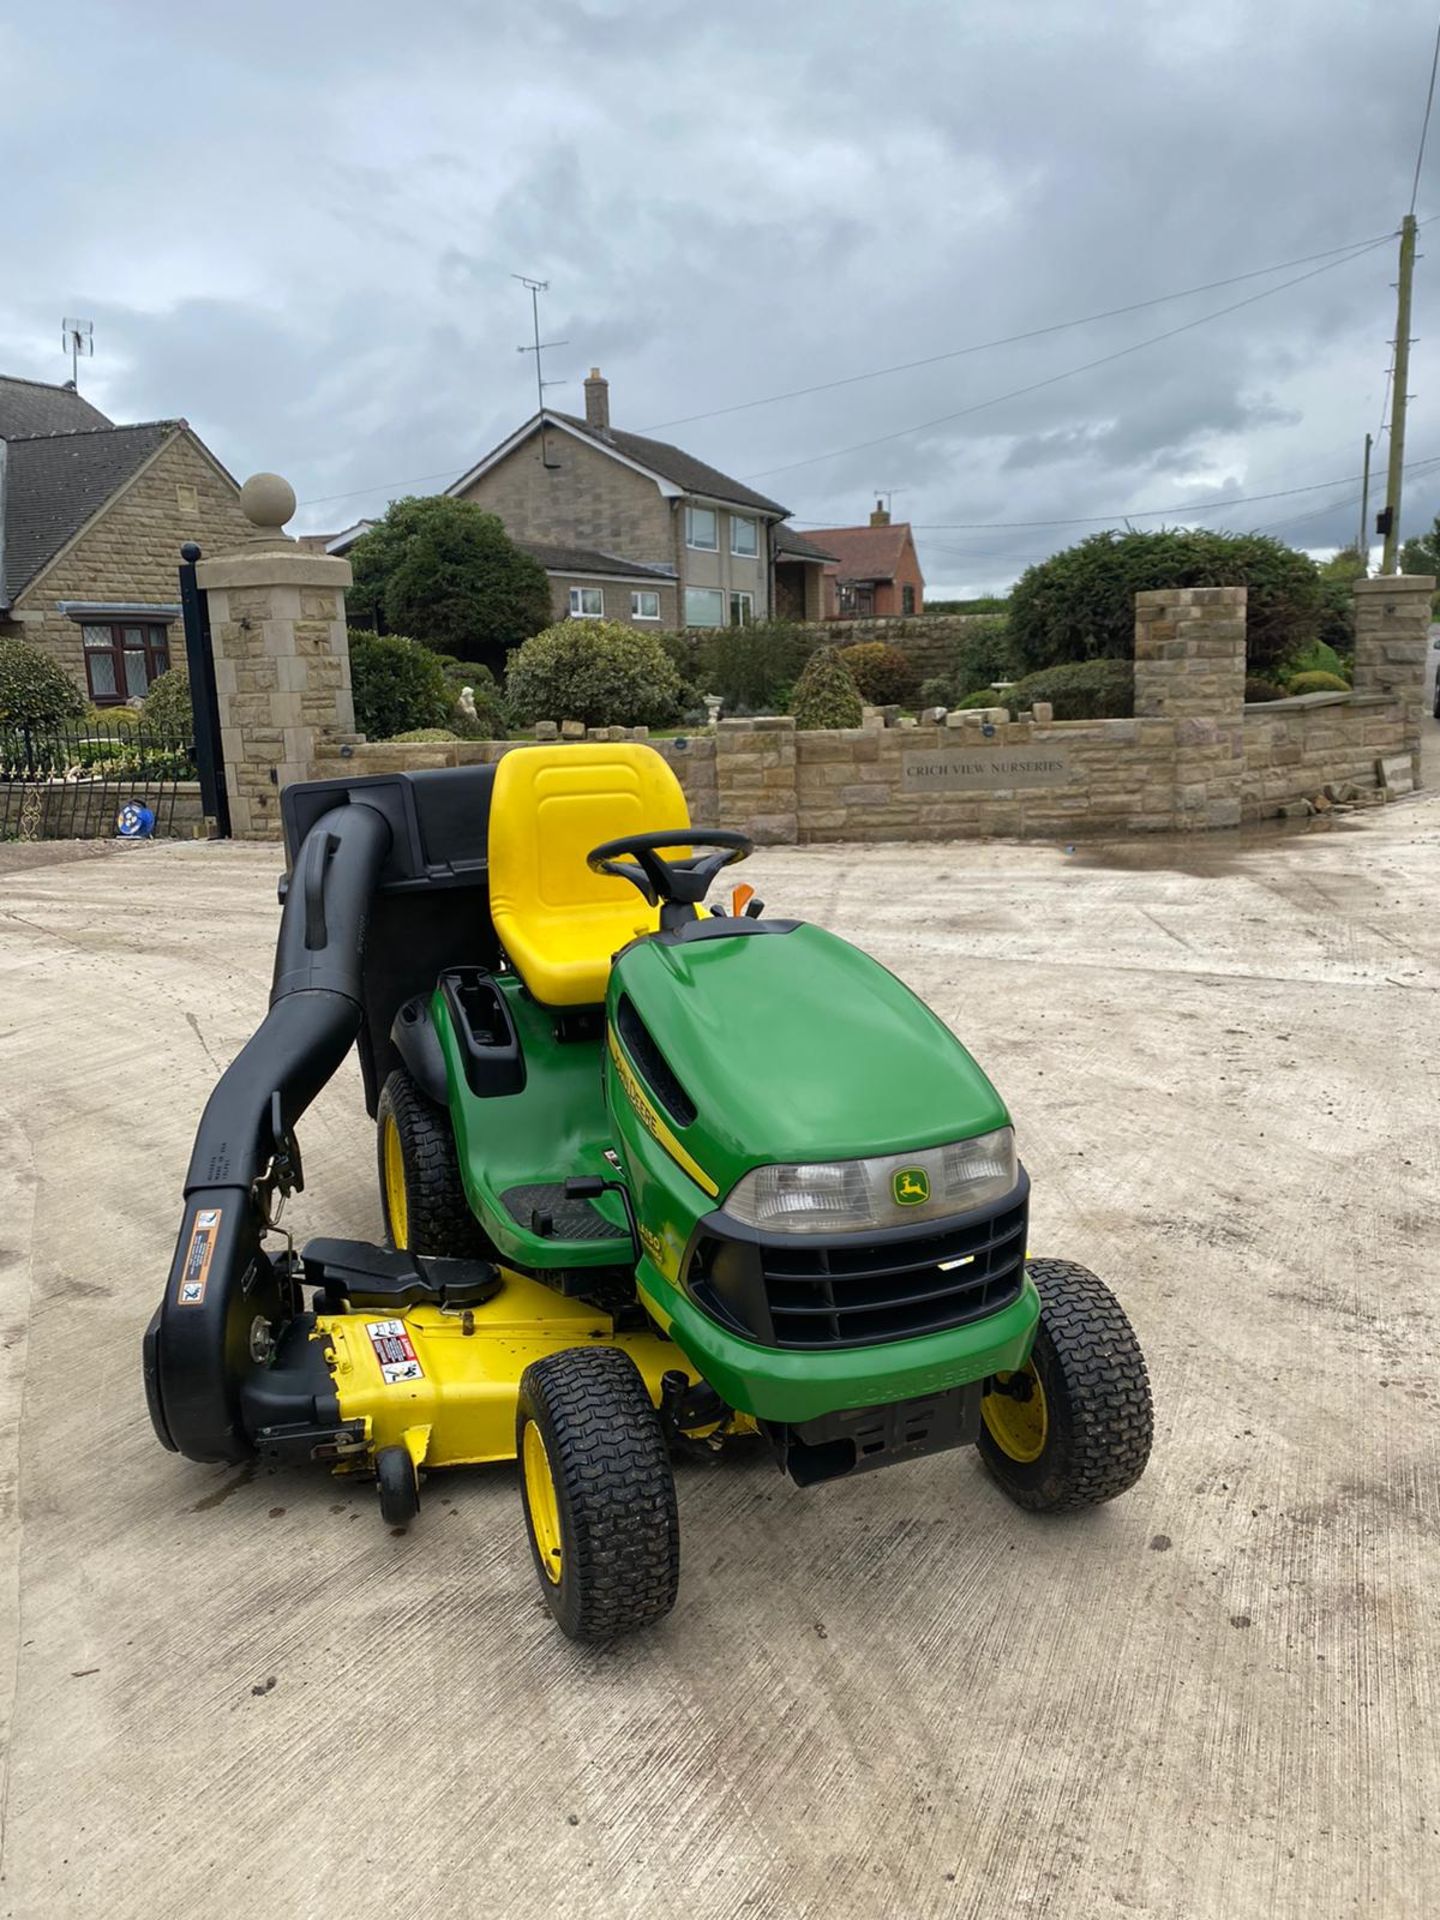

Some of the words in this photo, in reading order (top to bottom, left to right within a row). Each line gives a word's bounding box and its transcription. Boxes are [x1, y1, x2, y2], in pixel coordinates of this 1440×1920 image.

[906, 764, 948, 777] CRICH
[952, 763, 985, 775] VIEW
[991, 760, 1063, 774] NURSERIES
[628, 1079, 658, 1136] DEERE
[922, 1358, 998, 1391] DEERE
